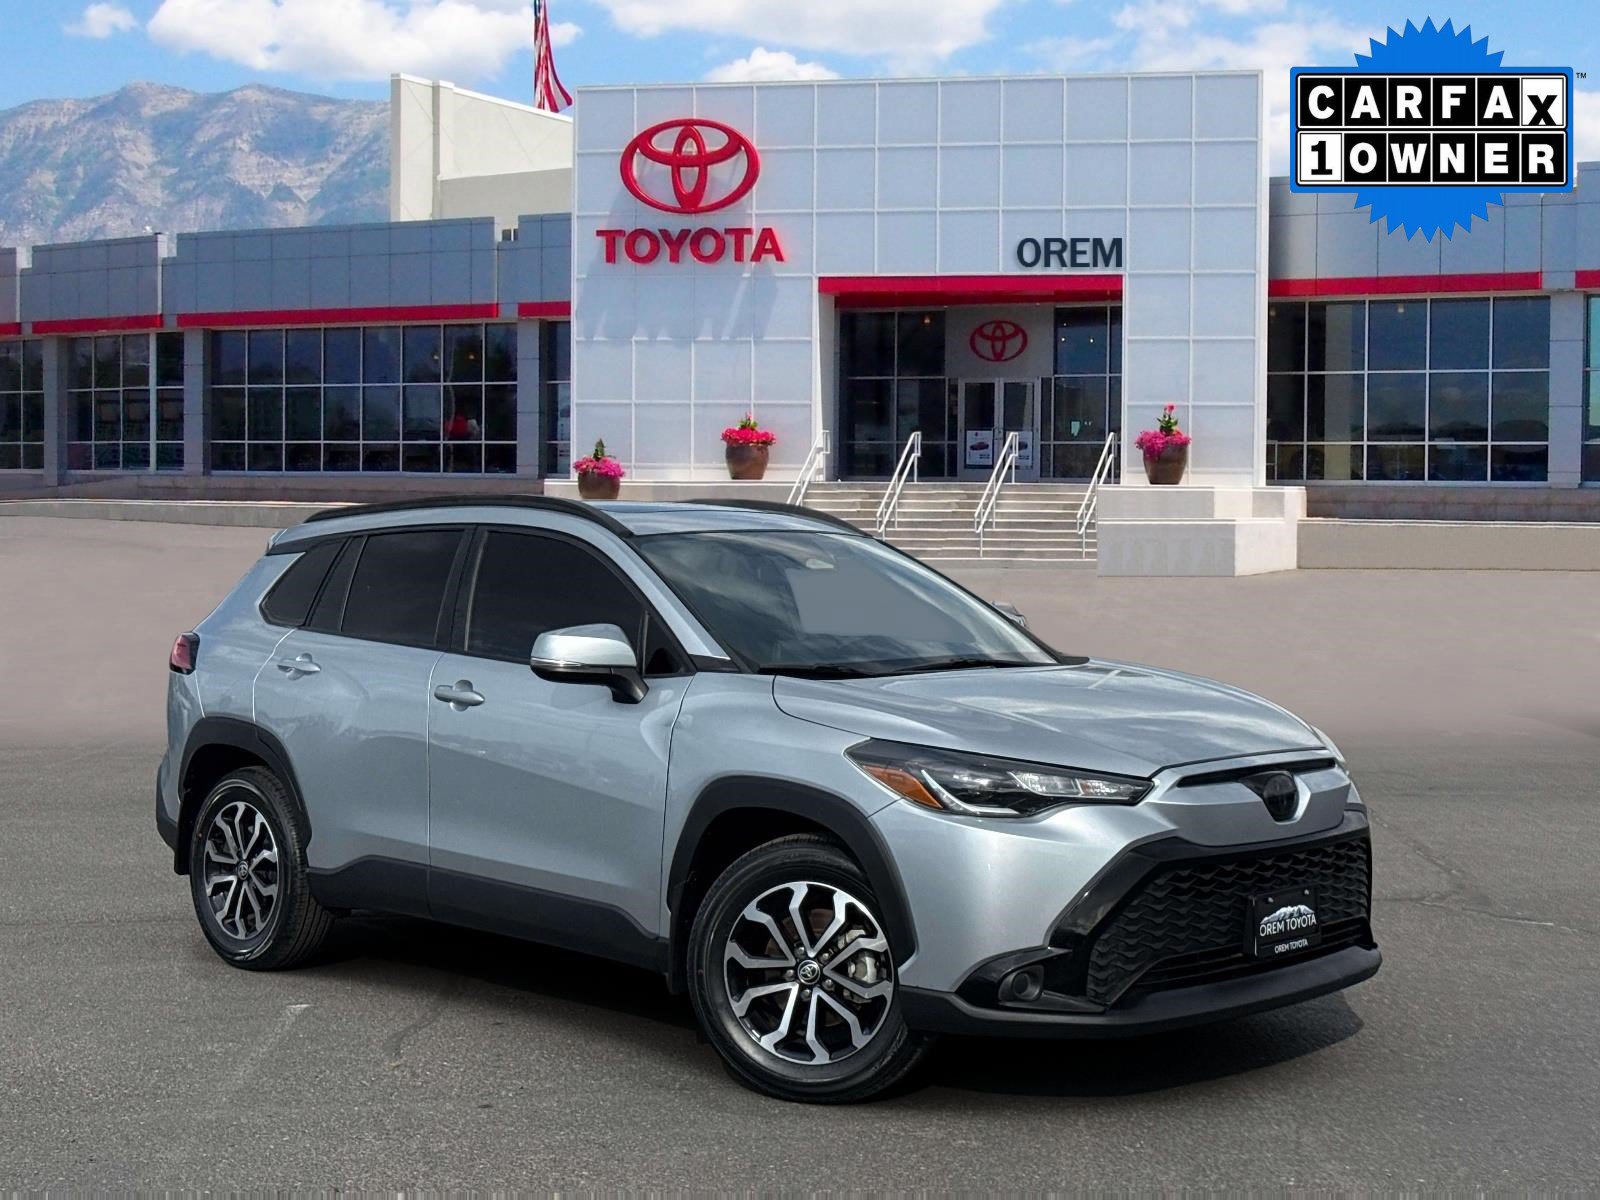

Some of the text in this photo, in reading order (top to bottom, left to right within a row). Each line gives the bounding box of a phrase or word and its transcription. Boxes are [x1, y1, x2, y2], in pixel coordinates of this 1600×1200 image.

[596, 227, 784, 264] TOYOTA
[1017, 237, 1122, 268] OREM
[1260, 914, 1317, 937] OREM TOYOTA
[1274, 939, 1308, 954] OREM TOYOTA
